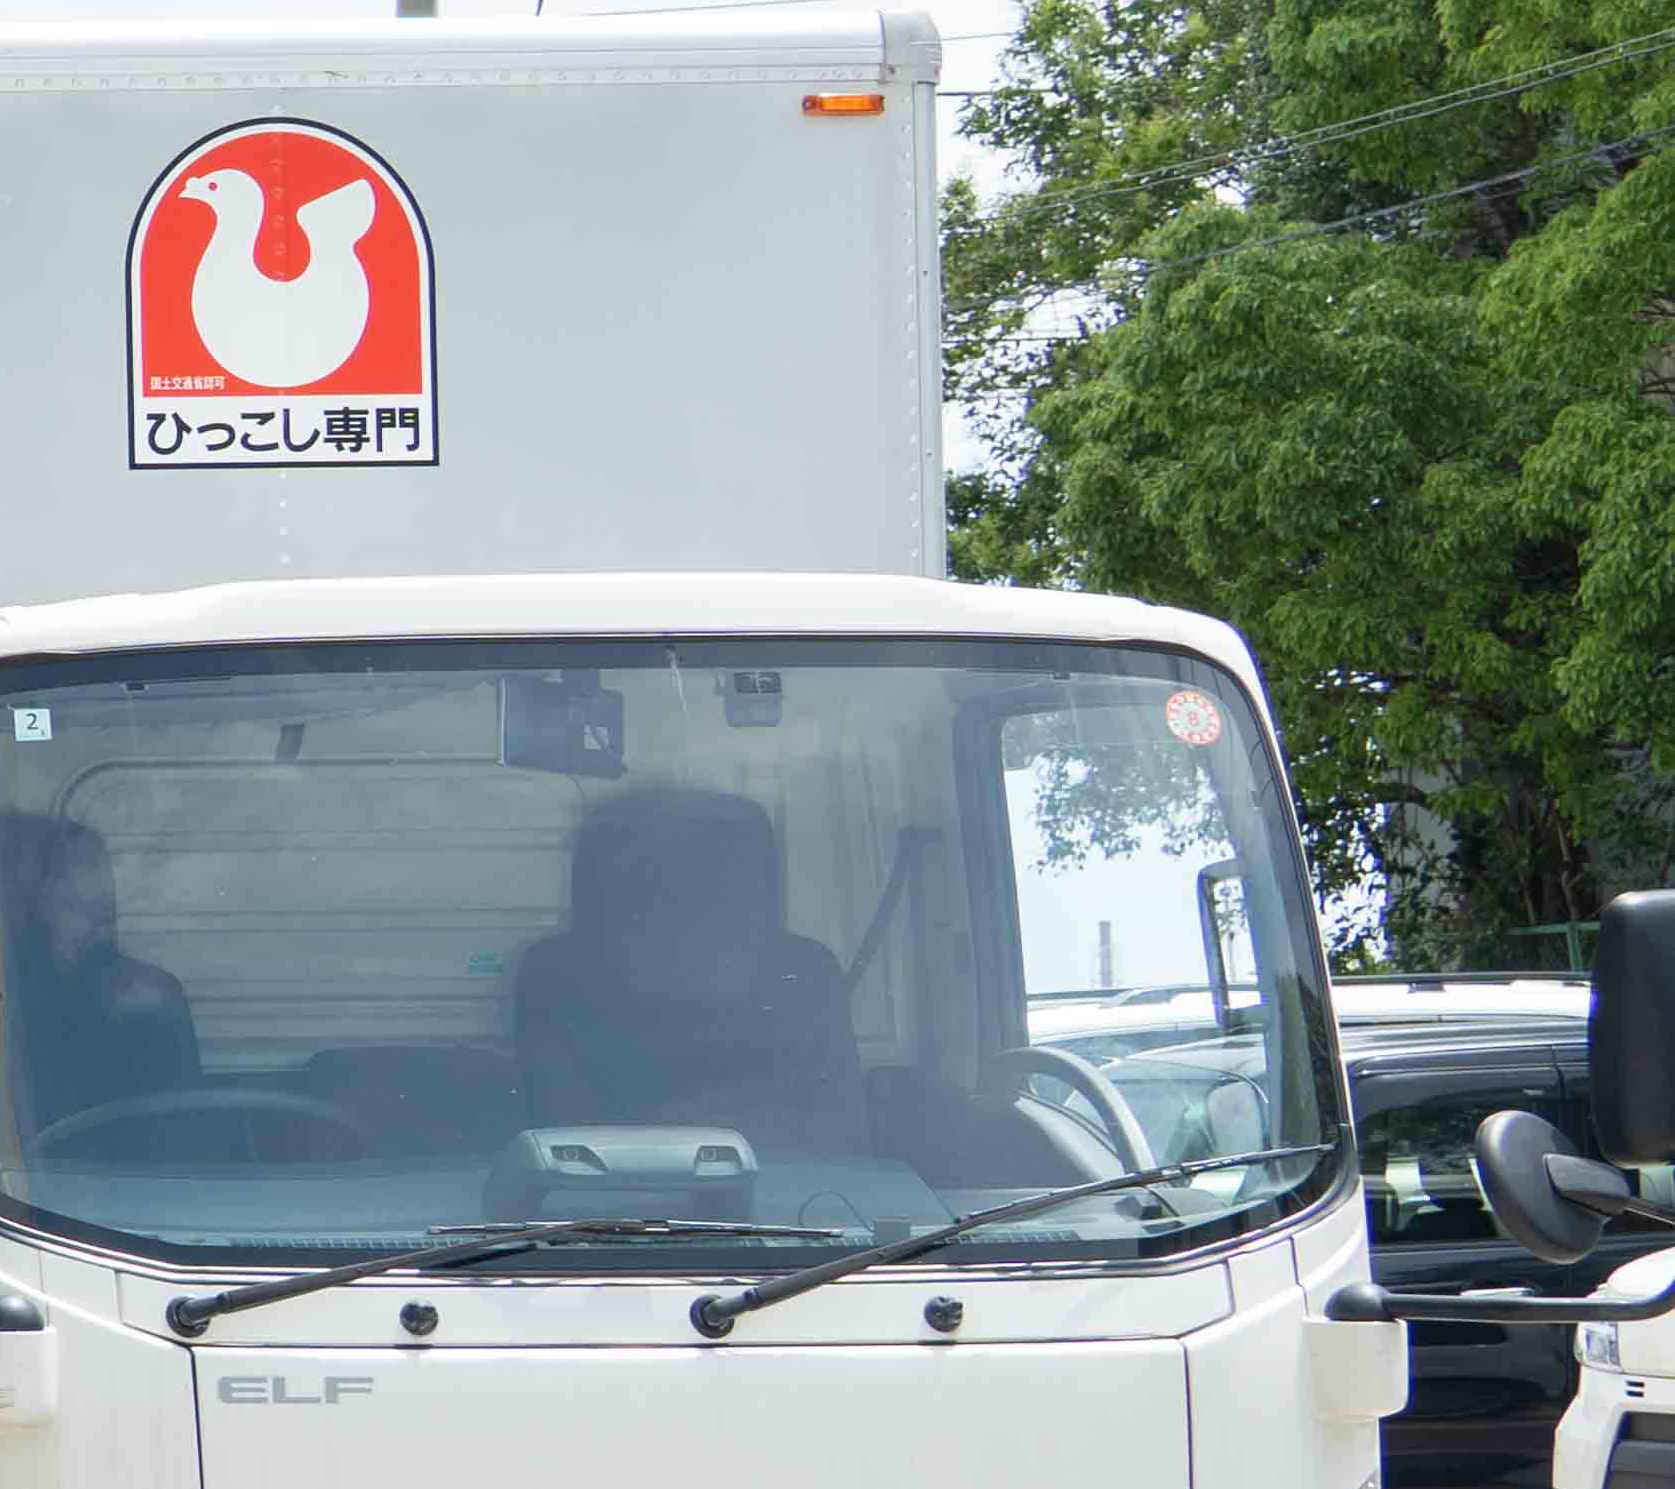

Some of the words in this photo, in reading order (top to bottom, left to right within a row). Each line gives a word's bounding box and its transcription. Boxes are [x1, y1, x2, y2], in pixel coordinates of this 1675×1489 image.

[146, 407, 420, 456] ひっこし専門
[26, 712, 39, 730] 2
[218, 1376, 375, 1404] ELF
